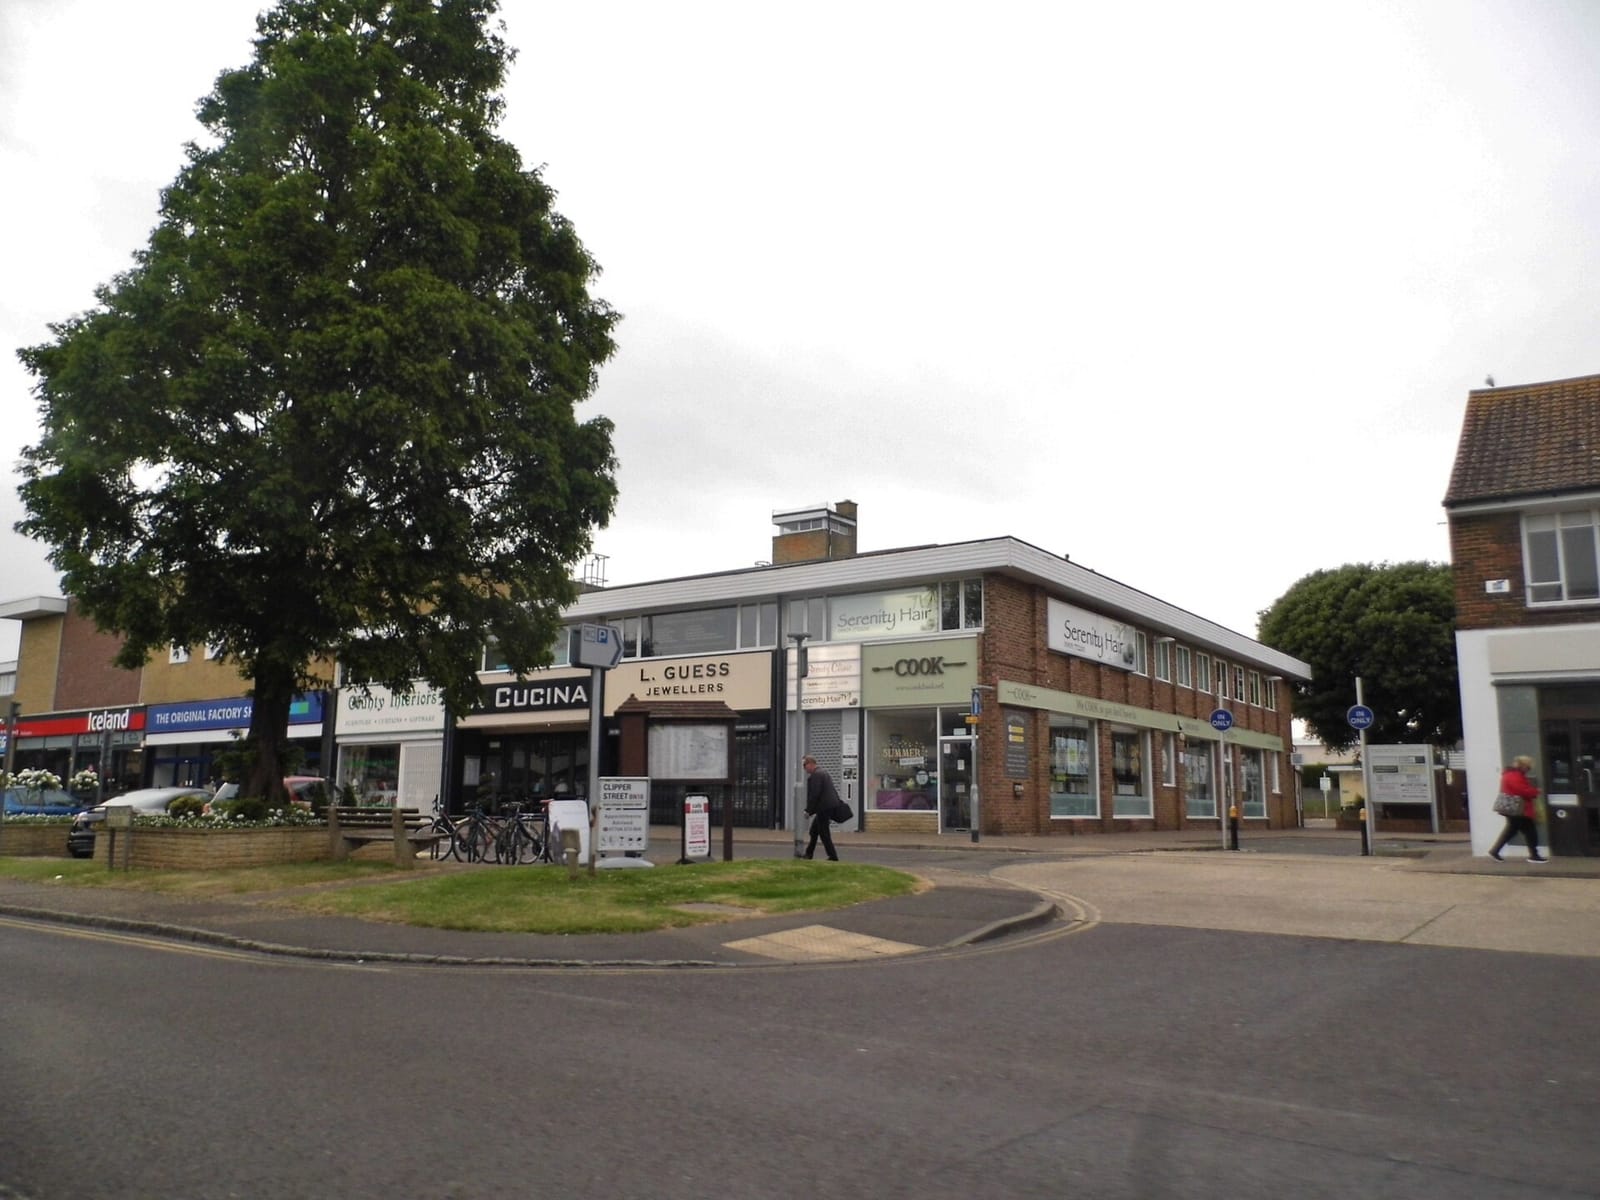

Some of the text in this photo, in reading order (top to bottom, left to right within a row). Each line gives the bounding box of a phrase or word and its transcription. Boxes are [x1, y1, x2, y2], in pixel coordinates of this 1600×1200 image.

[837, 608, 931, 630] Serenity Hair
[1064, 619, 1124, 658] Serenity Hair
[640, 662, 730, 682] L. GUESS
[894, 656, 944, 677] COOK
[495, 685, 588, 708] CUCINA
[646, 683, 724, 697] JEWELLERS
[390, 691, 437, 709] Interiors
[801, 695, 841, 705] erenity Hair
[87, 708, 130, 731] Iceland
[156, 713, 169, 724] THE
[170, 711, 206, 723] ORIGINAL
[208, 707, 242, 721] FACTORY
[1212, 719, 1230, 727] ONLY
[883, 748, 921, 758] SUMMER
[603, 783, 632, 791] CLIPPER
[603, 792, 628, 800] STREET
